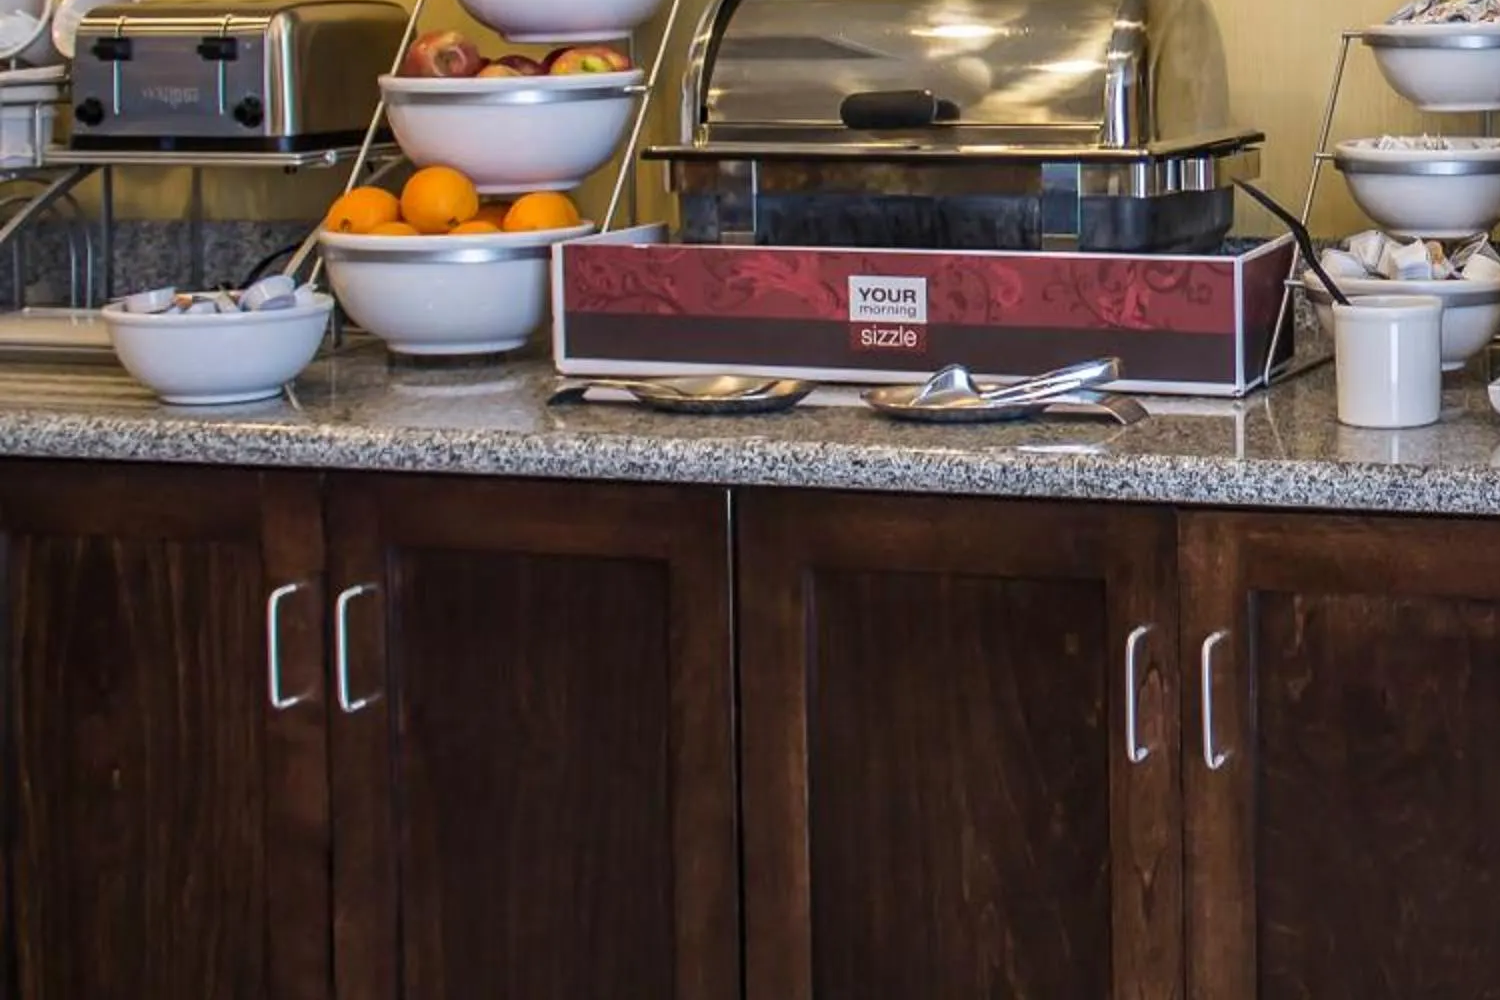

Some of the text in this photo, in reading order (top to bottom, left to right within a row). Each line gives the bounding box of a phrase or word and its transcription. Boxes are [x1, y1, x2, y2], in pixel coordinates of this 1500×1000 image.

[859, 287, 917, 304] YOUR
[859, 303, 917, 318] morning
[861, 324, 918, 347] sizzle
